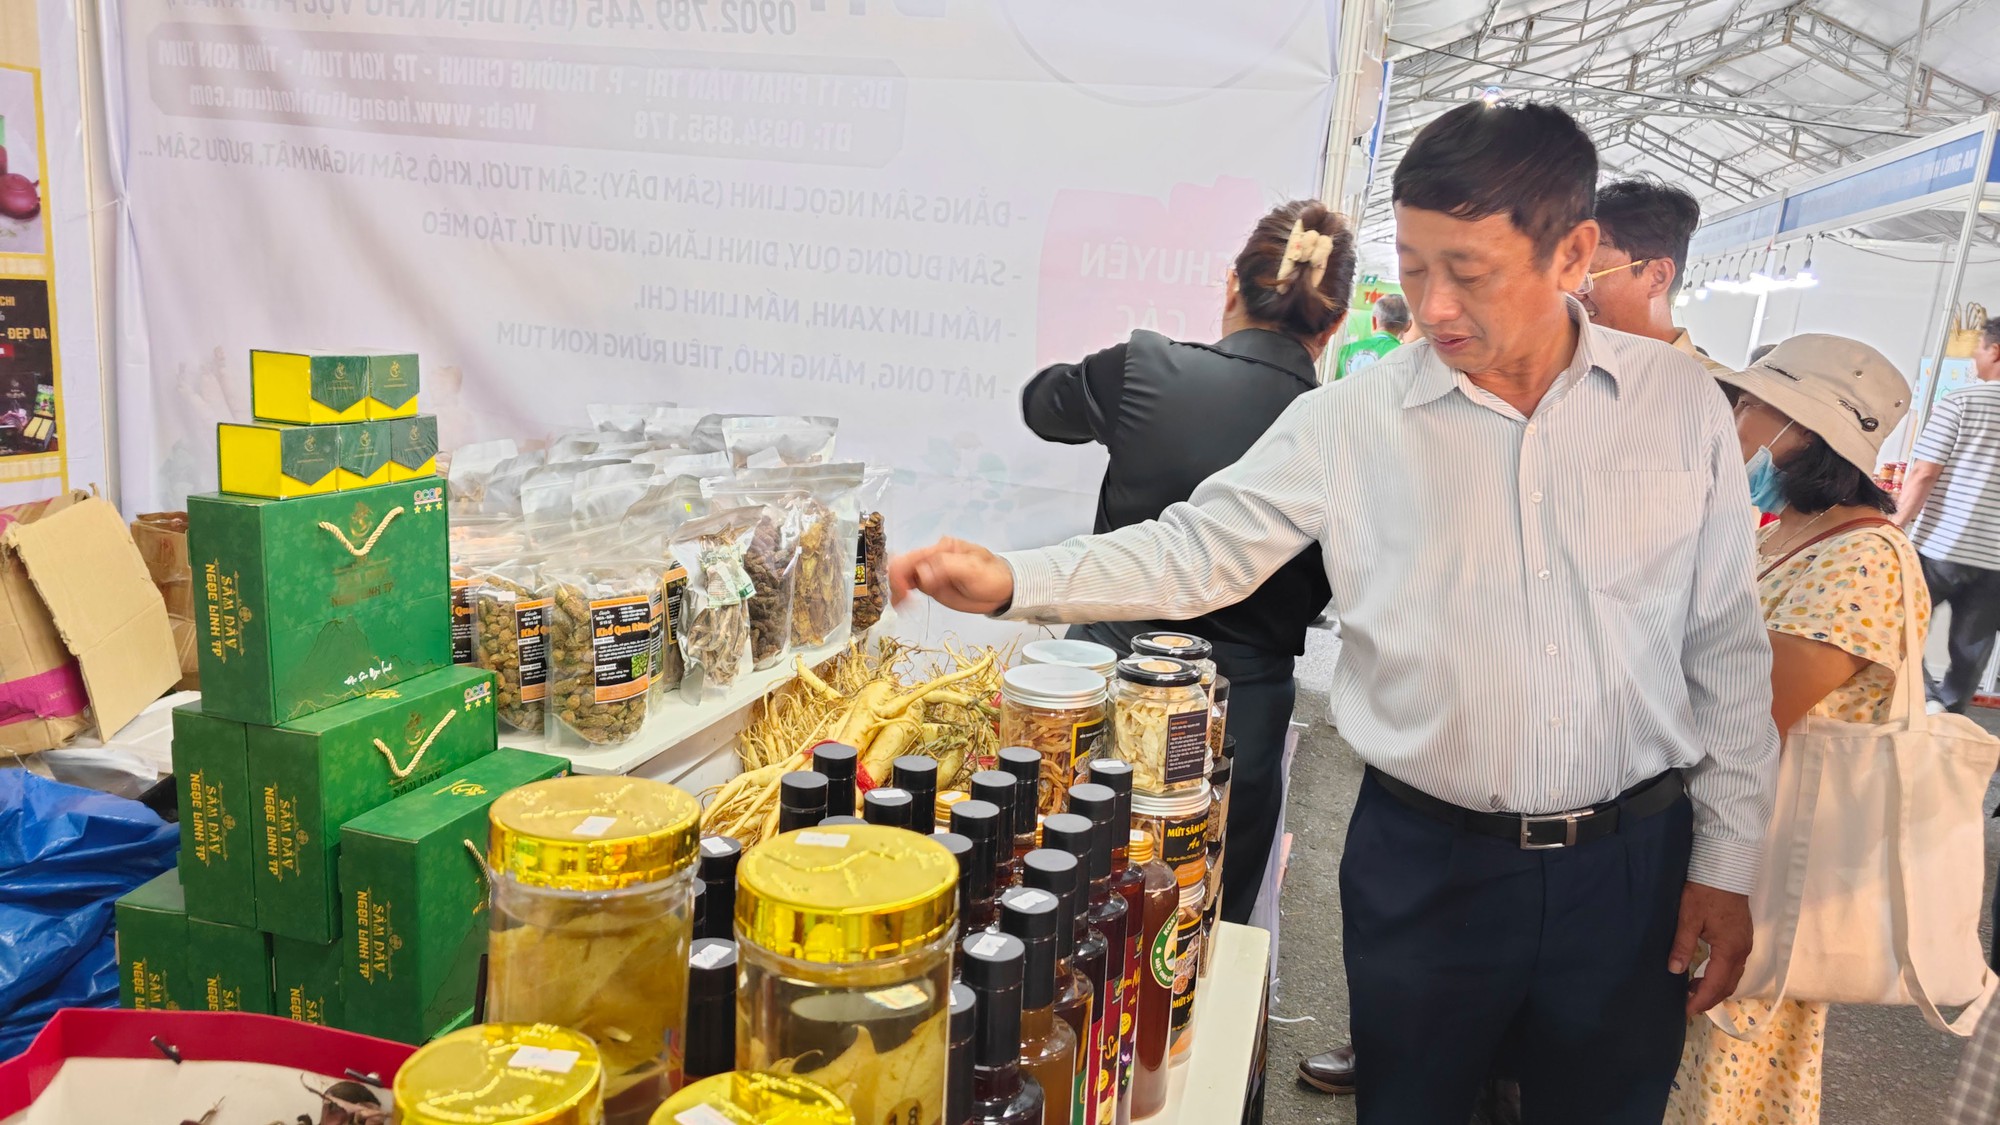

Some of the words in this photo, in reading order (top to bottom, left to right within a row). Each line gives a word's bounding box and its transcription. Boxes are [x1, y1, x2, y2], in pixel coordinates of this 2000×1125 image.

[7, 327, 31, 342] ĐẸP
[33, 327, 48, 340] DA
[205, 564, 219, 600] NGỌC
[221, 574, 236, 610] SÂM
[209, 603, 220, 638] LINH
[223, 613, 239, 649] DÂY
[614, 624, 631, 636] Qua
[189, 773, 203, 808] NGỌC
[205, 785, 220, 817] SÂM
[263, 787, 276, 823] NGỌC
[193, 811, 204, 842] LINH
[279, 799, 292, 832] SÂM
[1167, 826, 1185, 838] MỨT
[207, 820, 222, 854] DÂY
[266, 825, 278, 857] LINH
[281, 835, 295, 869] DÂY
[356, 891, 369, 926] NGỌC
[372, 903, 386, 936] SÂM
[359, 929, 371, 959] LINH
[373, 940, 388, 973] DÂY
[134, 997, 145, 1011] LI
[222, 988, 237, 1011] SÂ
